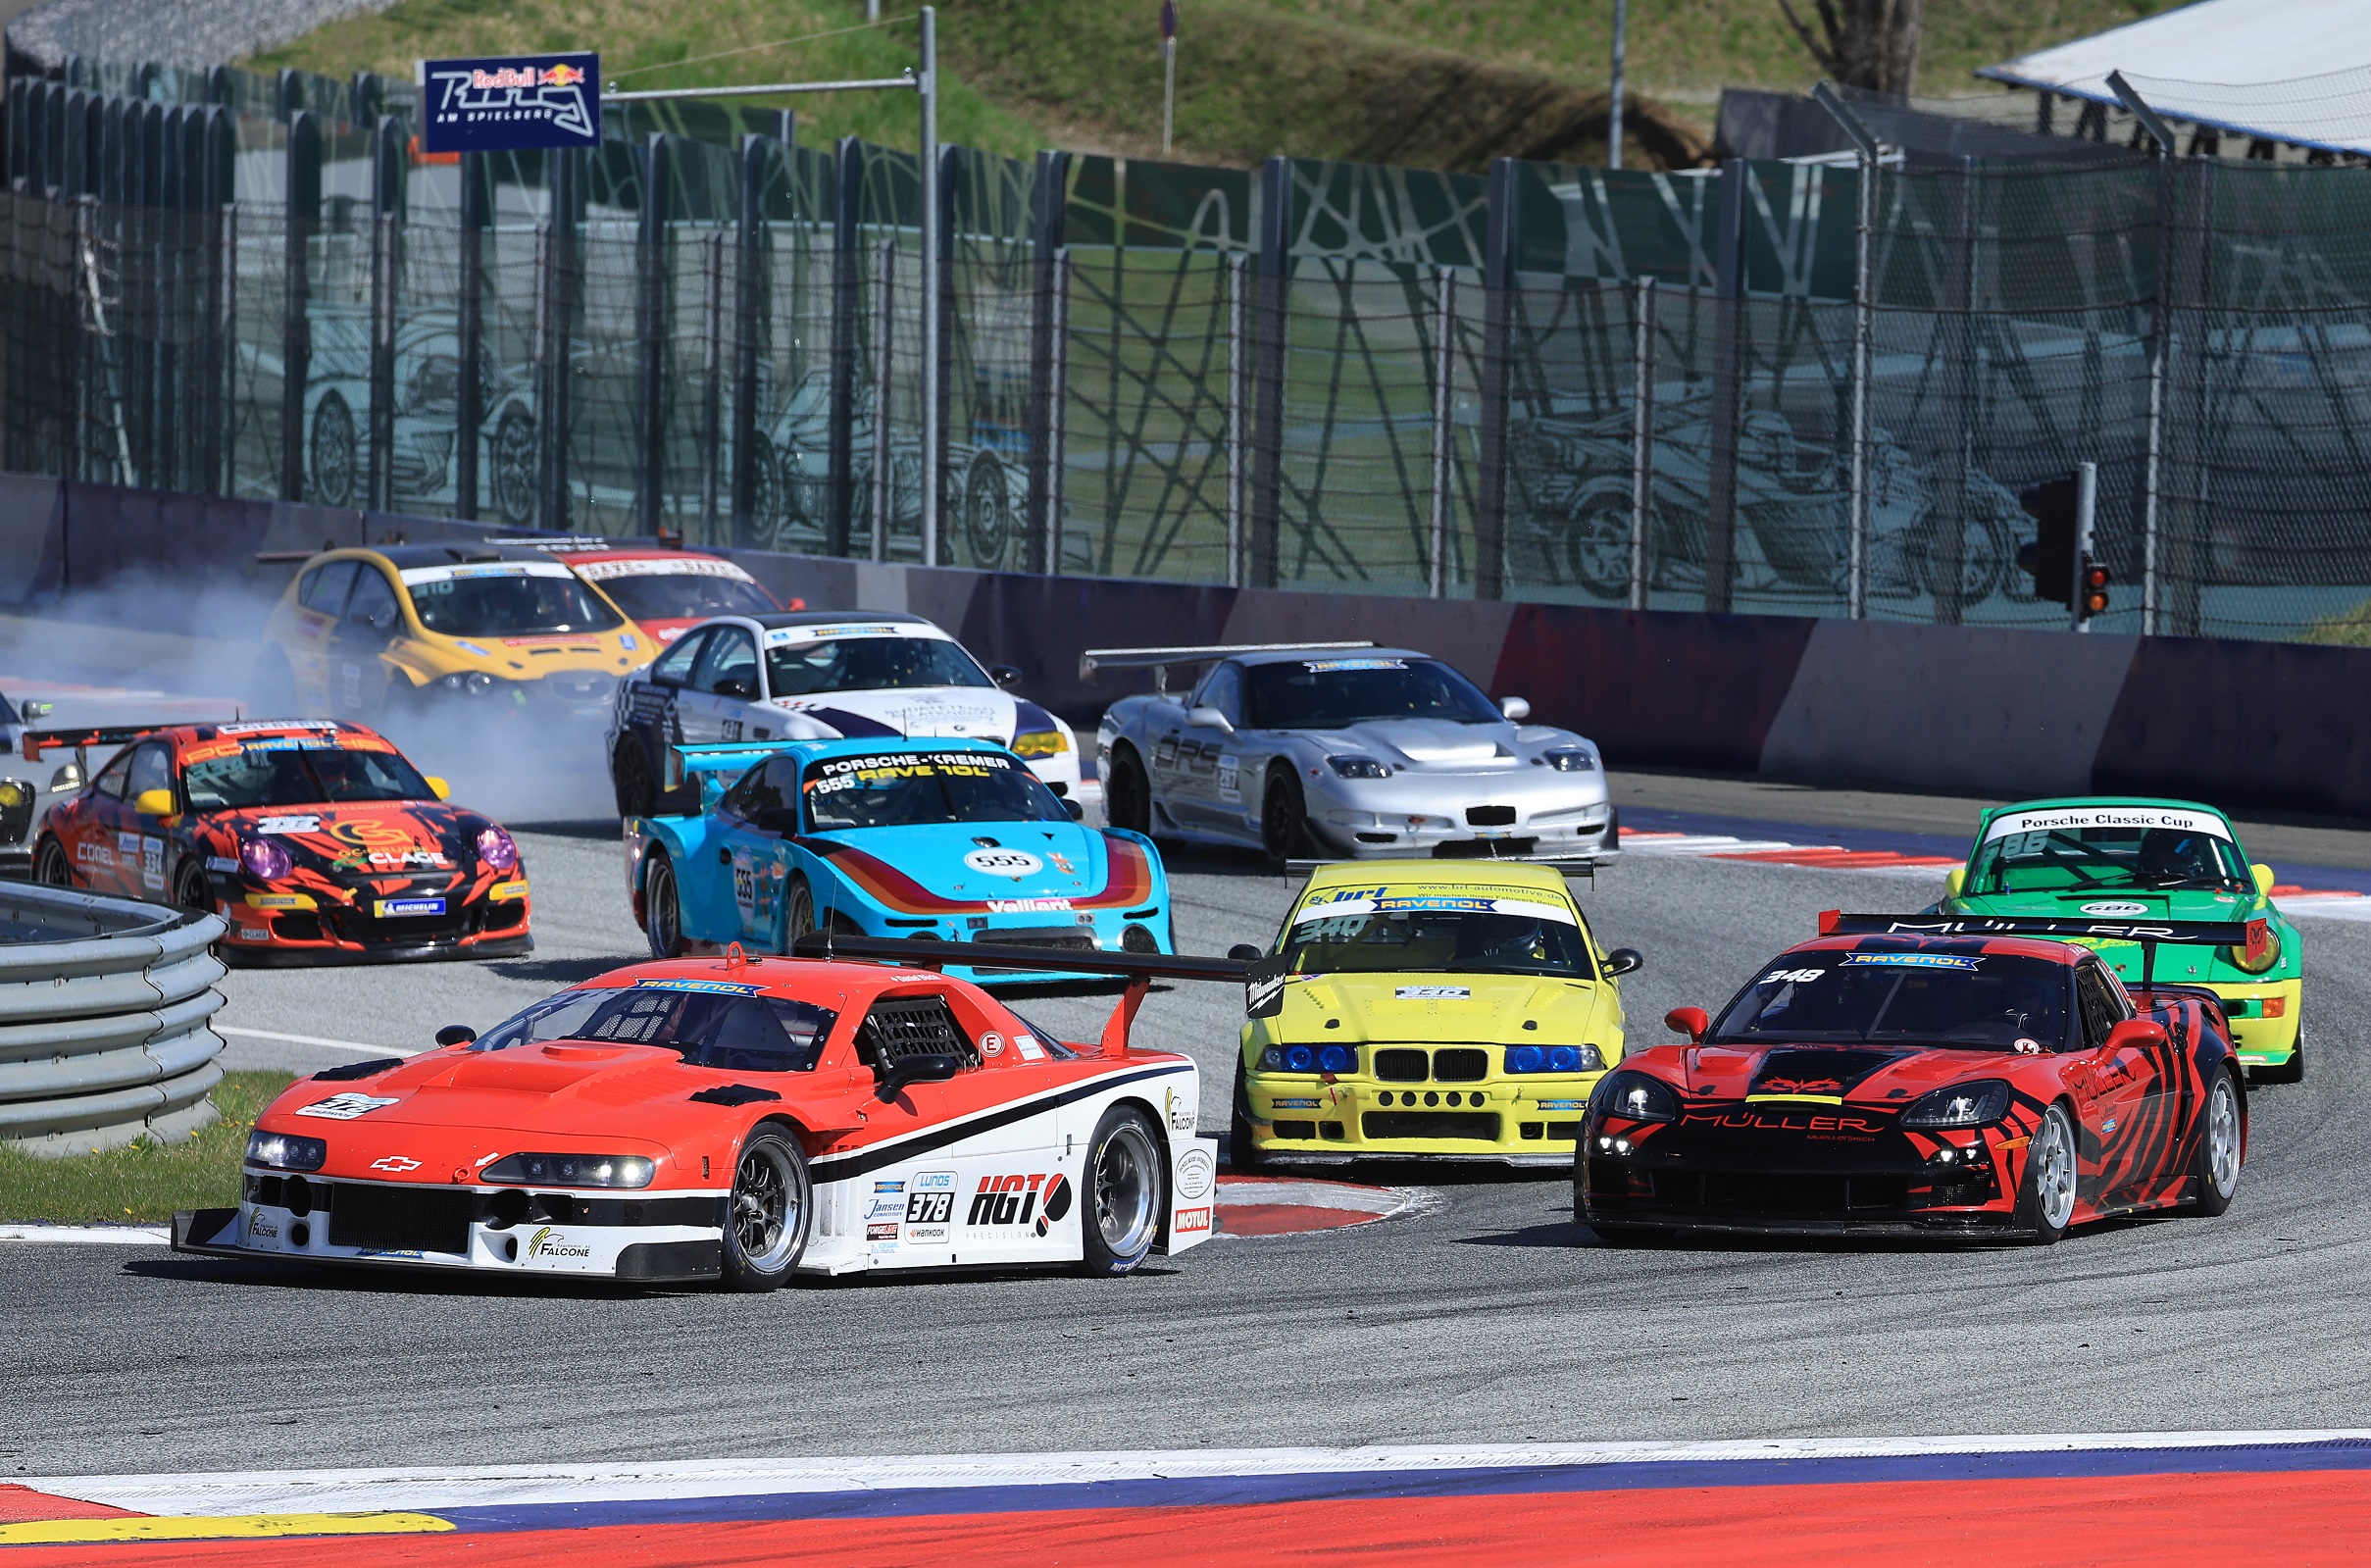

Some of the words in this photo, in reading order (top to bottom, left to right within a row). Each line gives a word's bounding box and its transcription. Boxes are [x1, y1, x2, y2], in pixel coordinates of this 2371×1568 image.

[436, 113, 458, 124] AM
[467, 109, 552, 123] SPIELBERG
[816, 776, 856, 794] 555
[2022, 815, 2090, 829] Porsche
[2094, 814, 2155, 826] Classic
[2160, 816, 2194, 829] Cup
[369, 851, 448, 865] CLAGE
[975, 855, 1031, 868] 555
[735, 868, 752, 900] 555
[1417, 884, 1562, 900] www.brt-automotive.de
[396, 901, 438, 912] MICHELIN
[986, 899, 1074, 913] Vaillant
[1381, 899, 1488, 910] RAVENOL
[1294, 914, 1369, 943] 340
[1855, 954, 1968, 967] RAVENOL
[1758, 969, 1826, 985] 348
[640, 980, 753, 994] RAVENOL
[1246, 972, 1286, 1005] Milwaukee
[986, 1037, 997, 1051] E
[313, 1098, 381, 1114] 378
[920, 1175, 950, 1188] LUNOS
[864, 1198, 905, 1220] Jansen
[908, 1193, 951, 1222] 378
[1177, 1209, 1209, 1230] MOTUL
[252, 1222, 278, 1239] FALCONE
[539, 1242, 590, 1257] FALCONE
